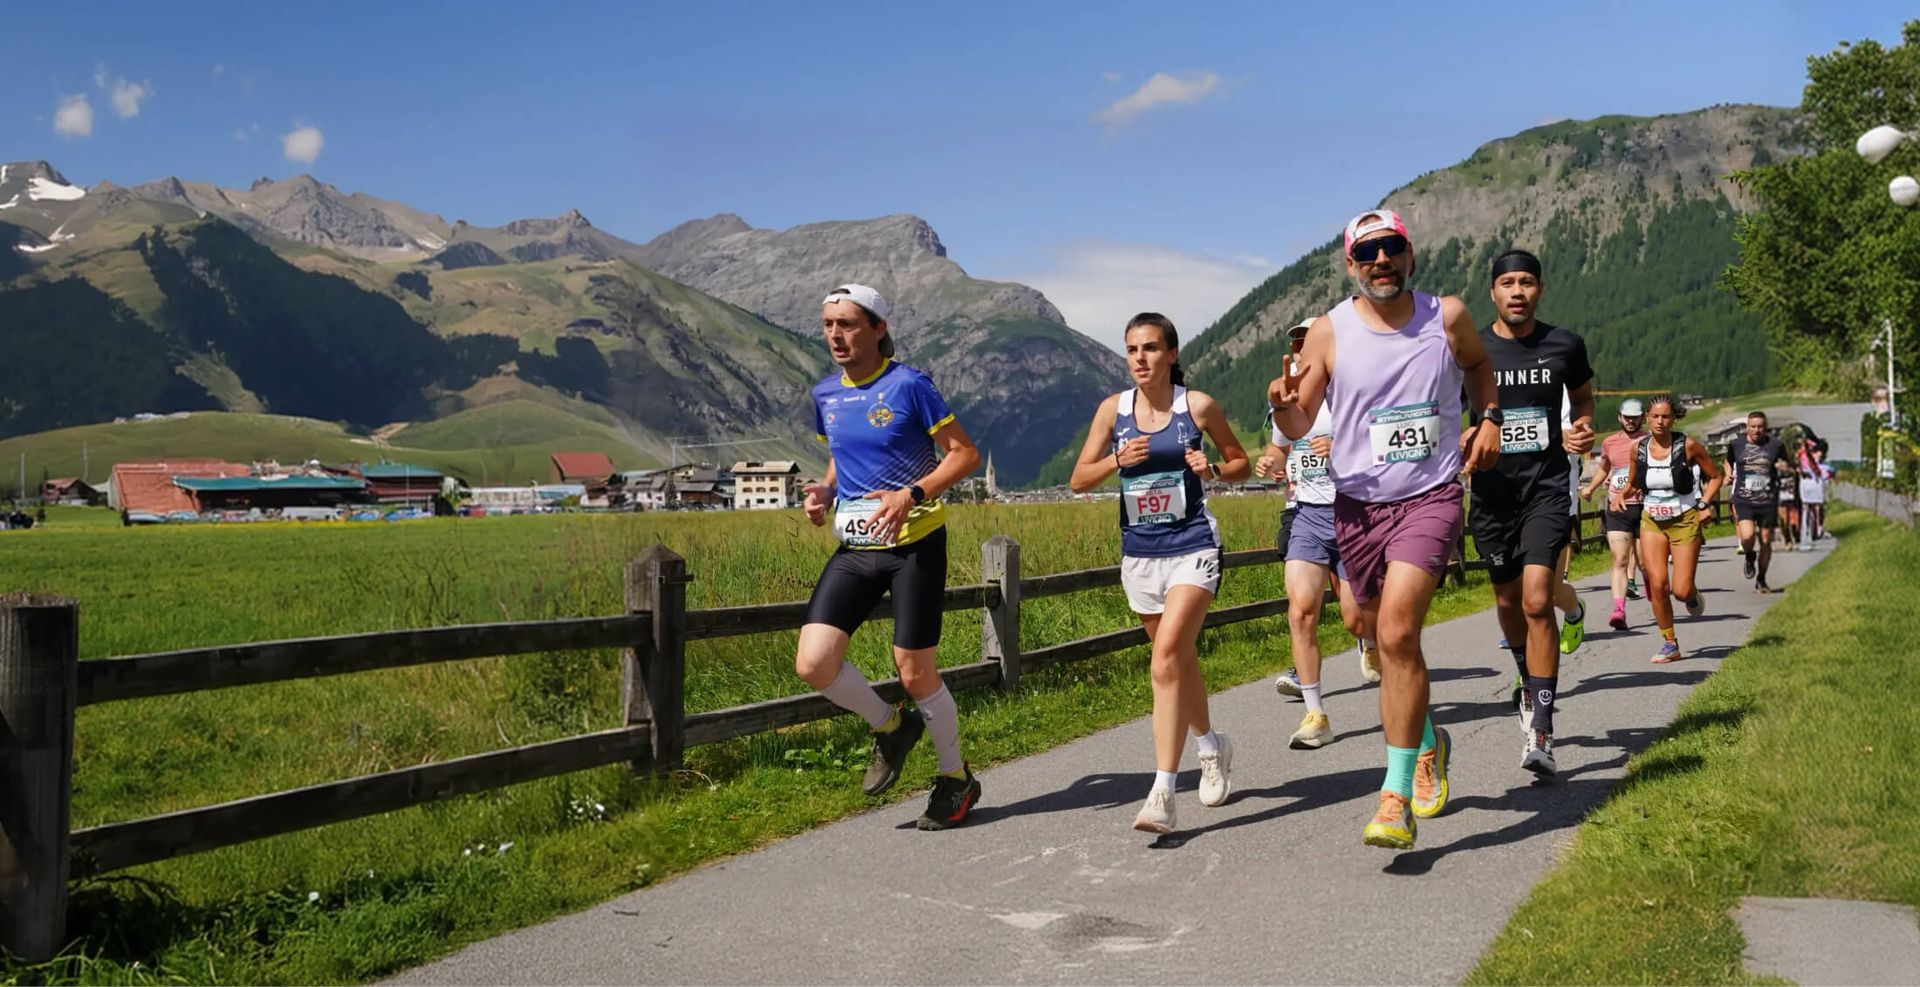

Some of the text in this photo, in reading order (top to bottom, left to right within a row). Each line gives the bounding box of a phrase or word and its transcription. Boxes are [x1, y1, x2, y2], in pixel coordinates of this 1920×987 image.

[1493, 368, 1552, 386] UNNER
[1388, 426, 1429, 448] 431
[1502, 426, 1538, 442] 525
[1301, 454, 1325, 468] 657
[1390, 448, 1429, 461] LIVIGNO
[1137, 495, 1171, 514] F97
